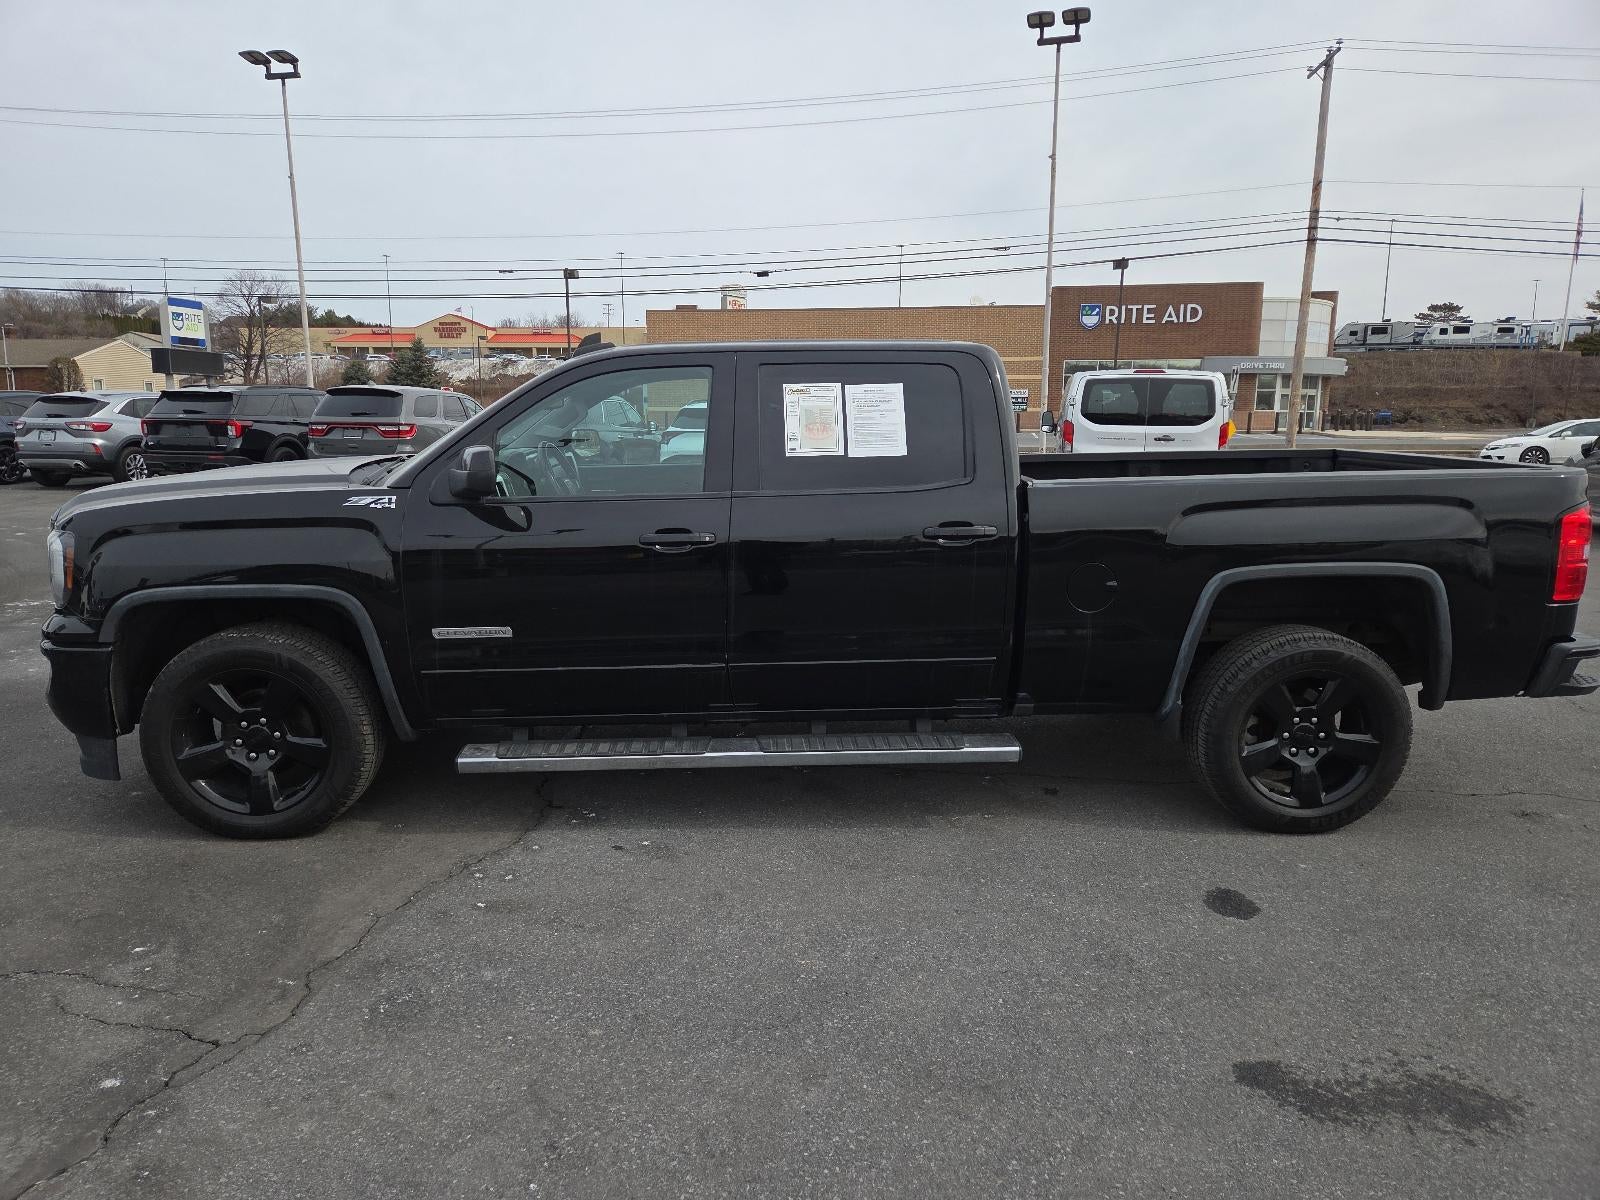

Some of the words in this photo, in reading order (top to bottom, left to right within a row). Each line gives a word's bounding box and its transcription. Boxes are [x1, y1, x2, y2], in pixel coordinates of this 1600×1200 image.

[185, 313, 202, 323] RITE
[1105, 304, 1156, 324] RITE
[1161, 303, 1203, 324] AID
[186, 323, 198, 332] AID
[1264, 361, 1285, 369] THRU
[437, 628, 508, 637] ELEVATION
